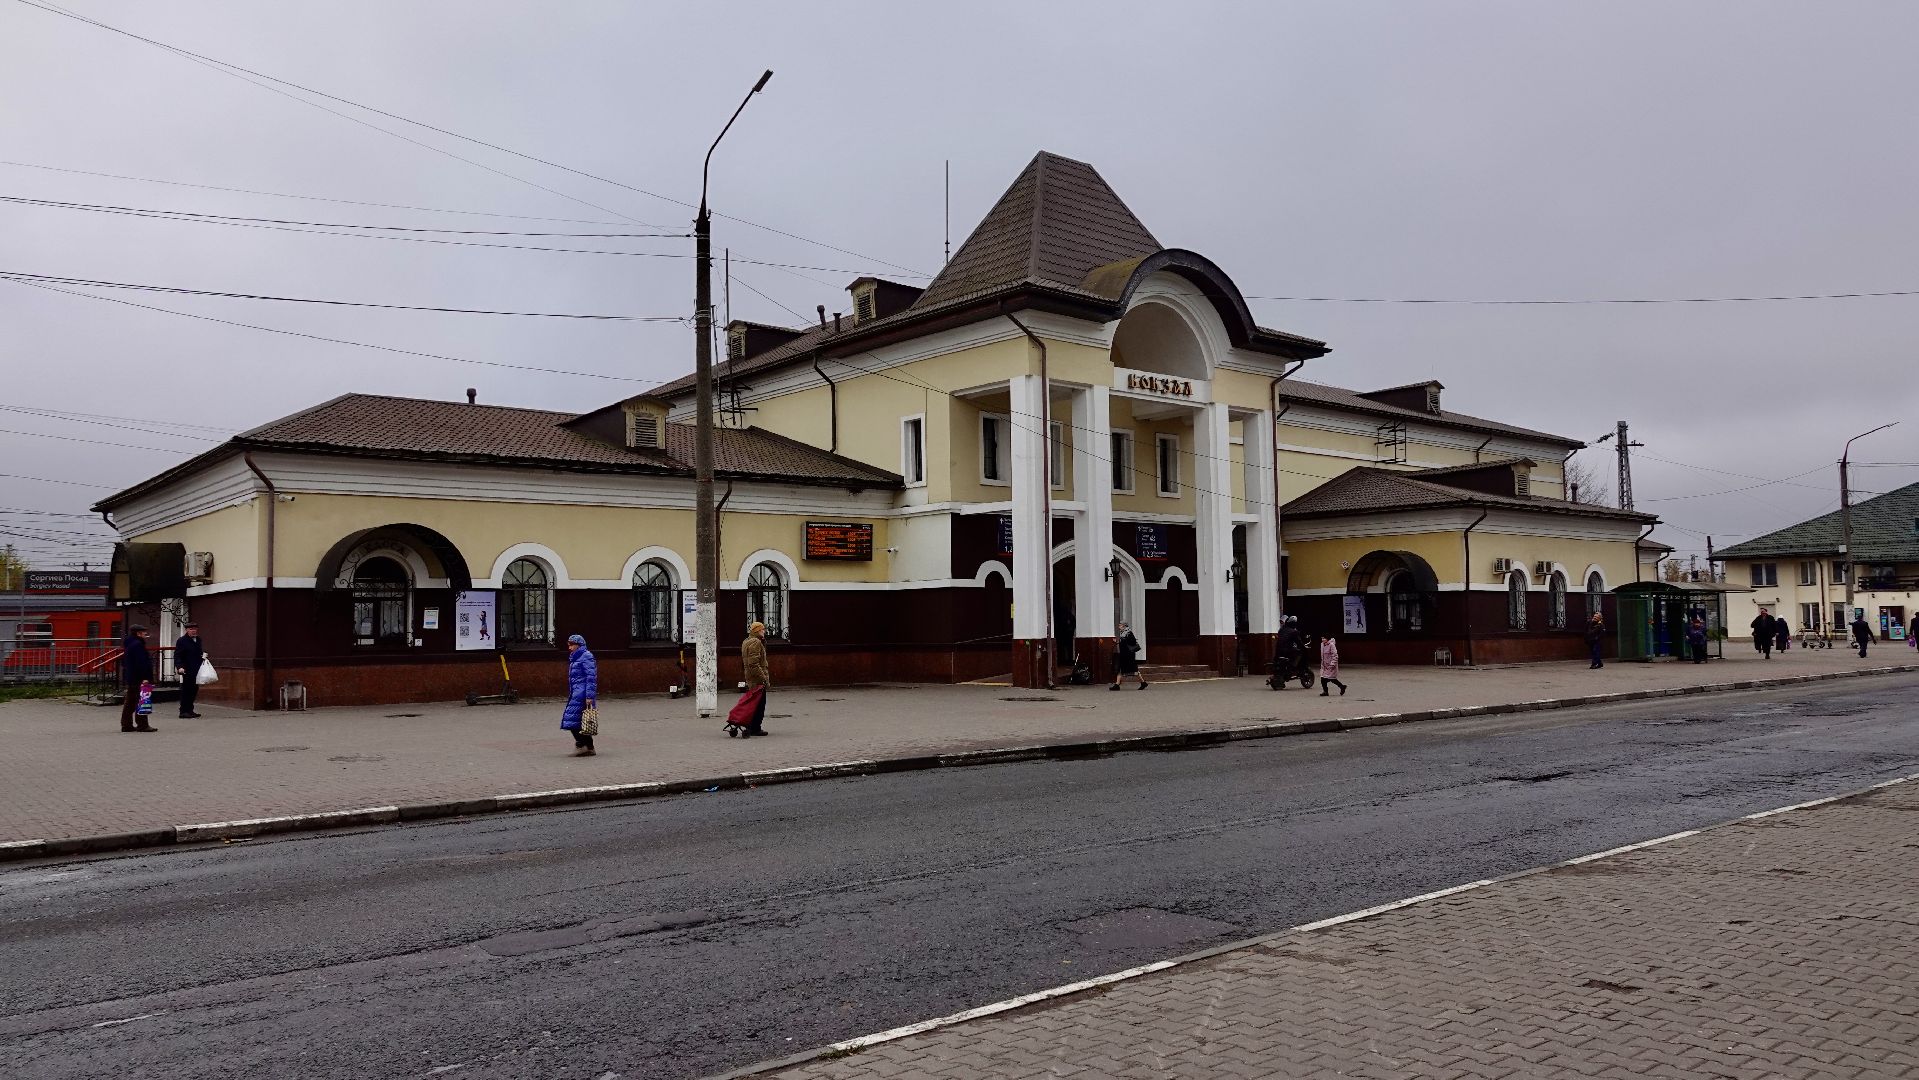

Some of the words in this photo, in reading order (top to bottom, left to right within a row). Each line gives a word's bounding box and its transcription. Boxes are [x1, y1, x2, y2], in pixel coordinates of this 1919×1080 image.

[1127, 374, 1193, 397] ВОКЗАЛ
[29, 574, 63, 582] Сергиев
[64, 574, 89, 582] Посад
